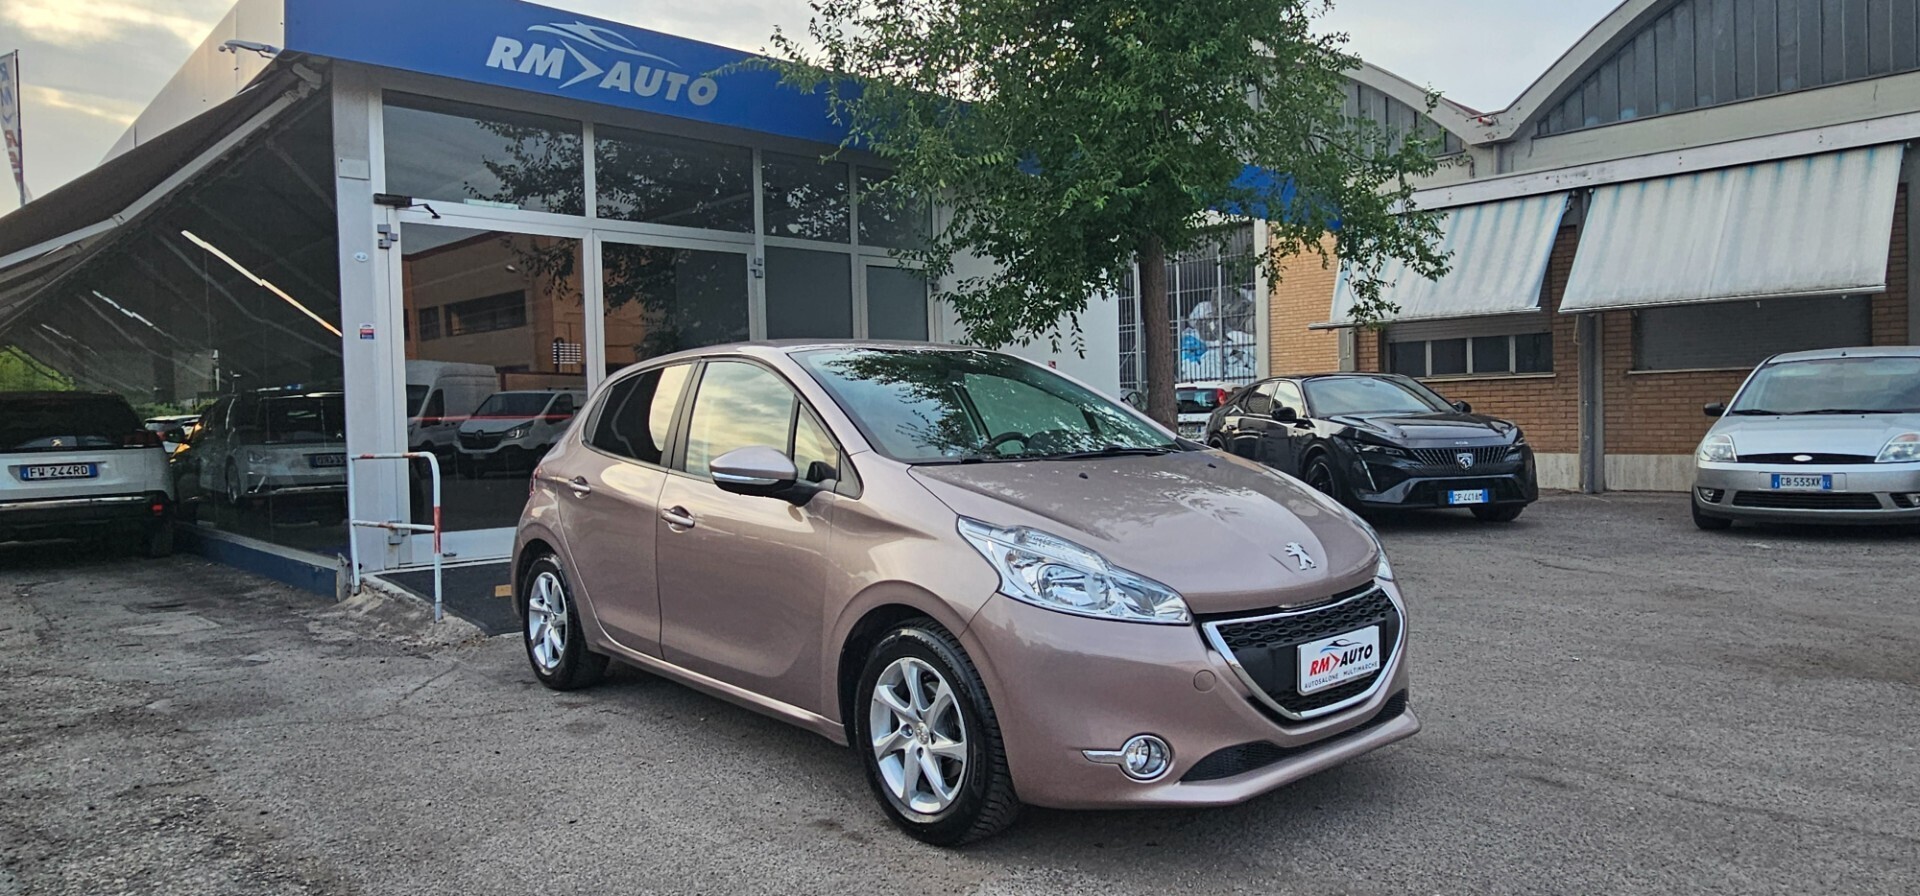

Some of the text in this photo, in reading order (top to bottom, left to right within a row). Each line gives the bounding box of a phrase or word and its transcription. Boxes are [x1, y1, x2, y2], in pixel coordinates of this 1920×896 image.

[486, 36, 718, 106] RM AUTO
[30, 465, 88, 477] FW 244RD
[1781, 477, 1792, 487] CB
[1794, 477, 1821, 487] 533XK
[1309, 644, 1373, 676] RM AUTO
[1304, 661, 1378, 689] AUTOSALONE MULTIMARCHE
